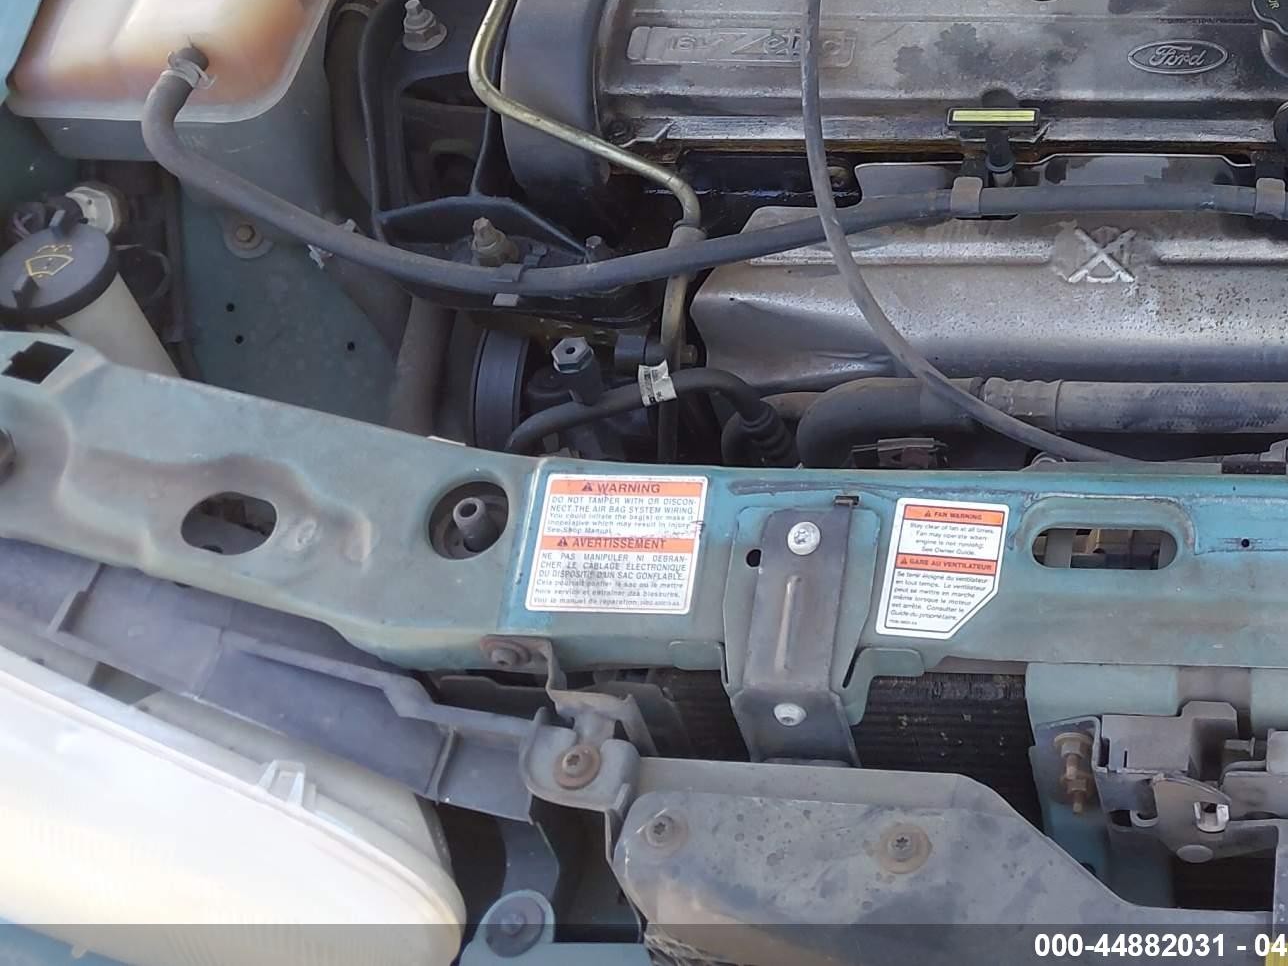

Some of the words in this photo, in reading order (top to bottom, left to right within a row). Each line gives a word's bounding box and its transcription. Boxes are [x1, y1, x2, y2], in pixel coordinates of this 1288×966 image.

[731, 28, 842, 56] Zetc
[1151, 45, 1205, 66] Ford
[597, 483, 661, 493] WARNING
[663, 498, 696, 506] DISCON-
[950, 512, 982, 520] WARNING
[572, 537, 667, 549] AVERTISSEMENT
[584, 553, 628, 561] MANIPULER
[540, 561, 562, 569] CHER
[943, 561, 992, 570] VENTILATEUR
